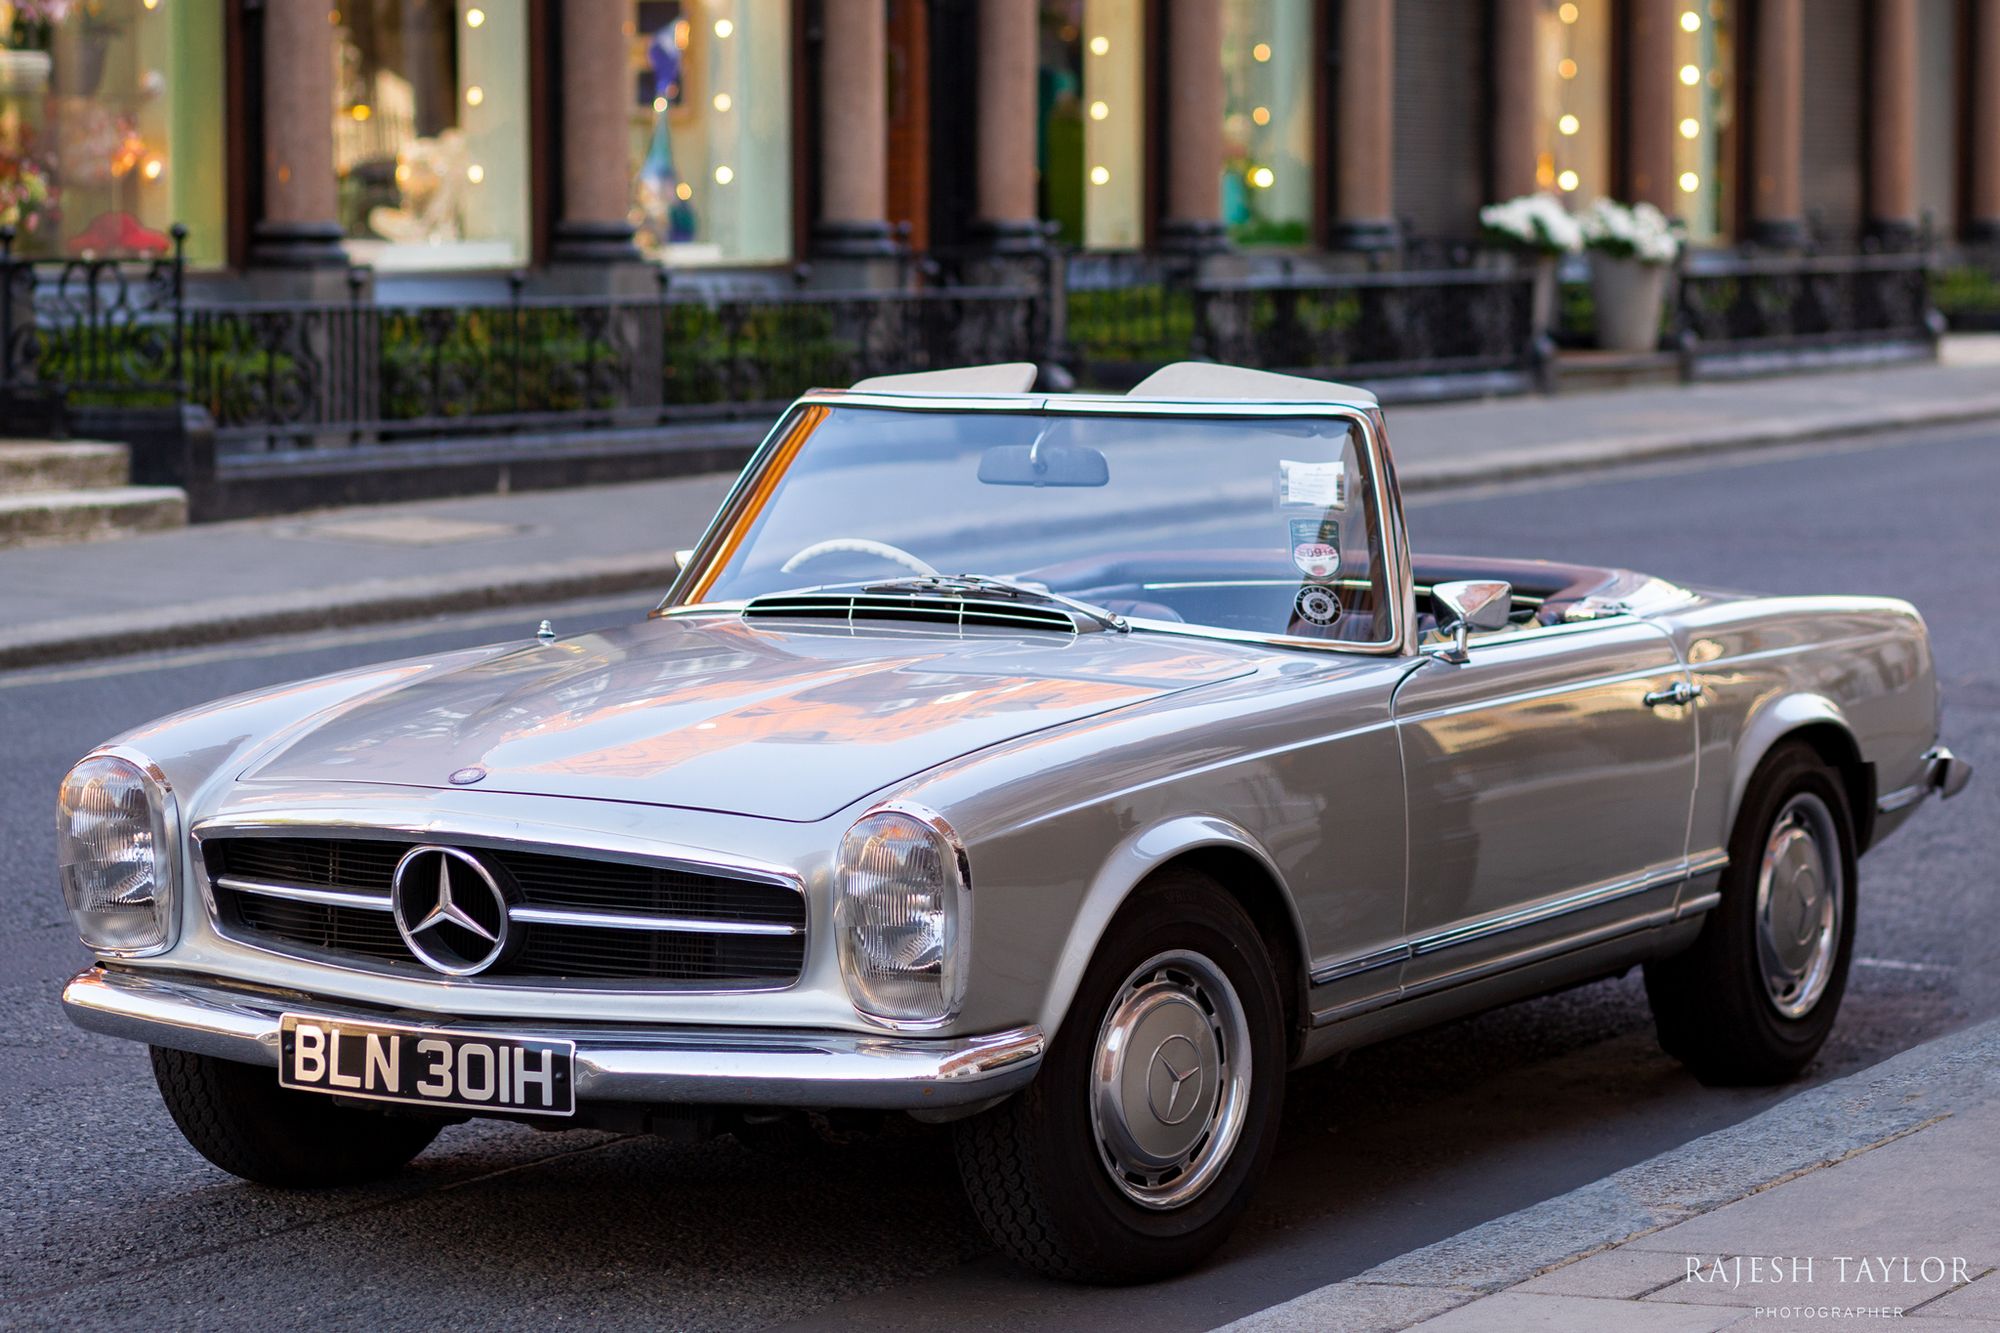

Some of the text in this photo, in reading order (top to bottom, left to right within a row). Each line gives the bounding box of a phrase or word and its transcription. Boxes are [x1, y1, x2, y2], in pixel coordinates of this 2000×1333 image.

[1298, 587, 1339, 608] CHELSEA
[1303, 613, 1330, 625] CARS
[295, 1024, 553, 1106] BLN 301H
